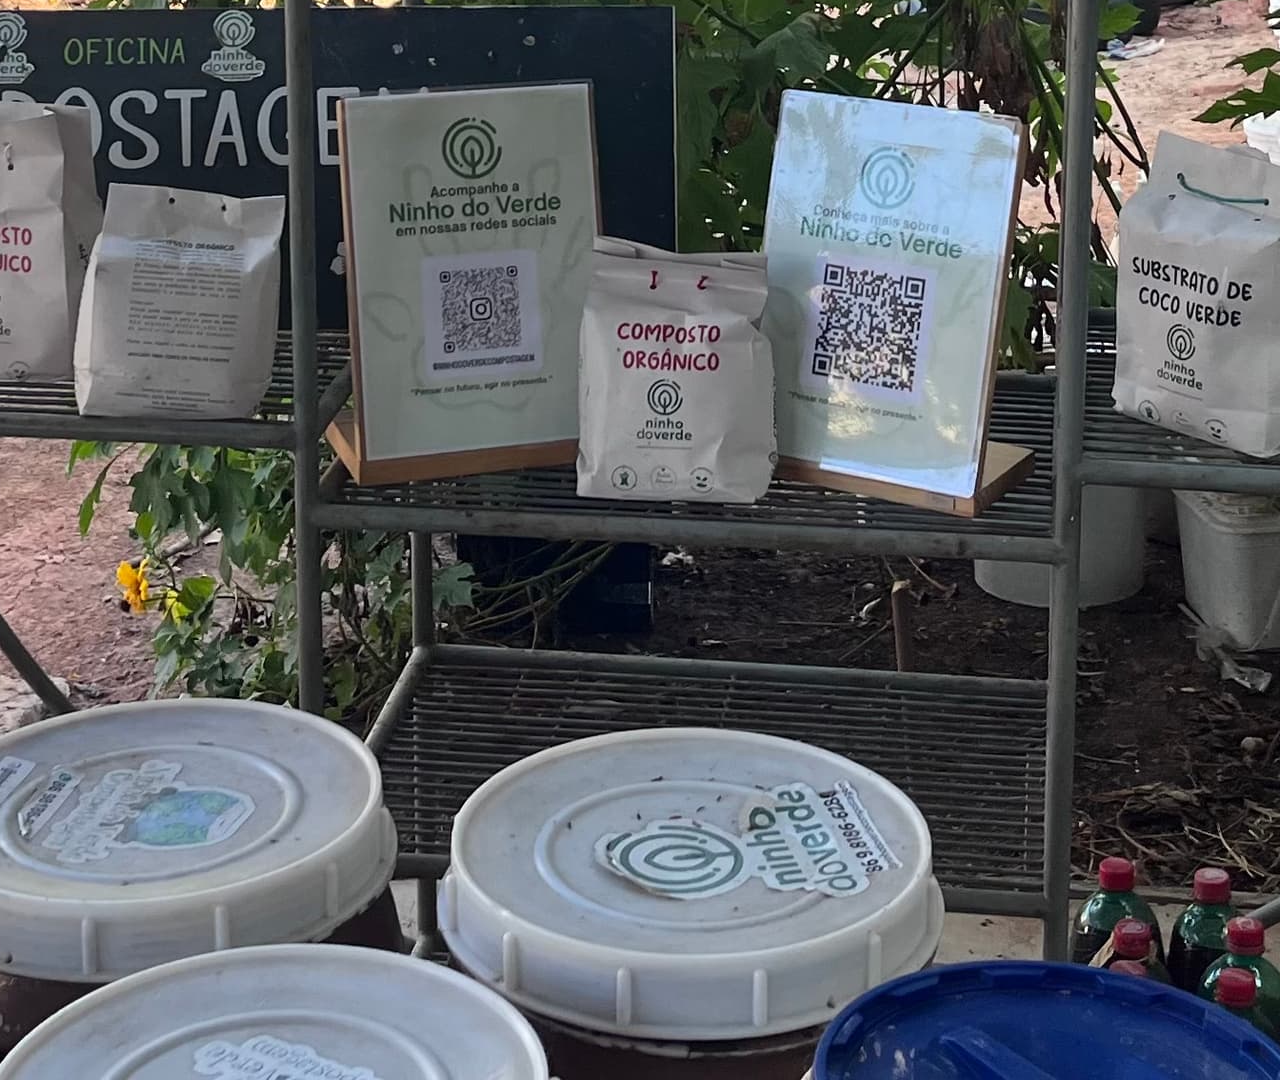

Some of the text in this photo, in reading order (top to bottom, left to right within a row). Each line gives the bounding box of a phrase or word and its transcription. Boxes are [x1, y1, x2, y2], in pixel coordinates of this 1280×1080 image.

[63, 37, 186, 66] OFICINA
[430, 182, 519, 198] Acompanhe a
[389, 192, 562, 223] Ninho do Verde
[396, 214, 557, 237] em nossas redes sociais
[800, 216, 858, 242] Ninho
[900, 231, 963, 259] Verde
[903, 219, 939, 233] sobre
[942, 226, 950, 235] a
[1132, 256, 1253, 302] SUBSTRATO DE
[1138, 286, 1242, 328] COCO VERDE
[617, 323, 721, 344] COMPOSTO
[623, 348, 720, 372] ORGÂNICO
[1163, 359, 1196, 378] ninho
[1157, 366, 1204, 391] doverde
[637, 429, 692, 441] doverde
[645, 418, 683, 430] ninho
[746, 806, 808, 886] ninho
[775, 789, 858, 892] doverde
